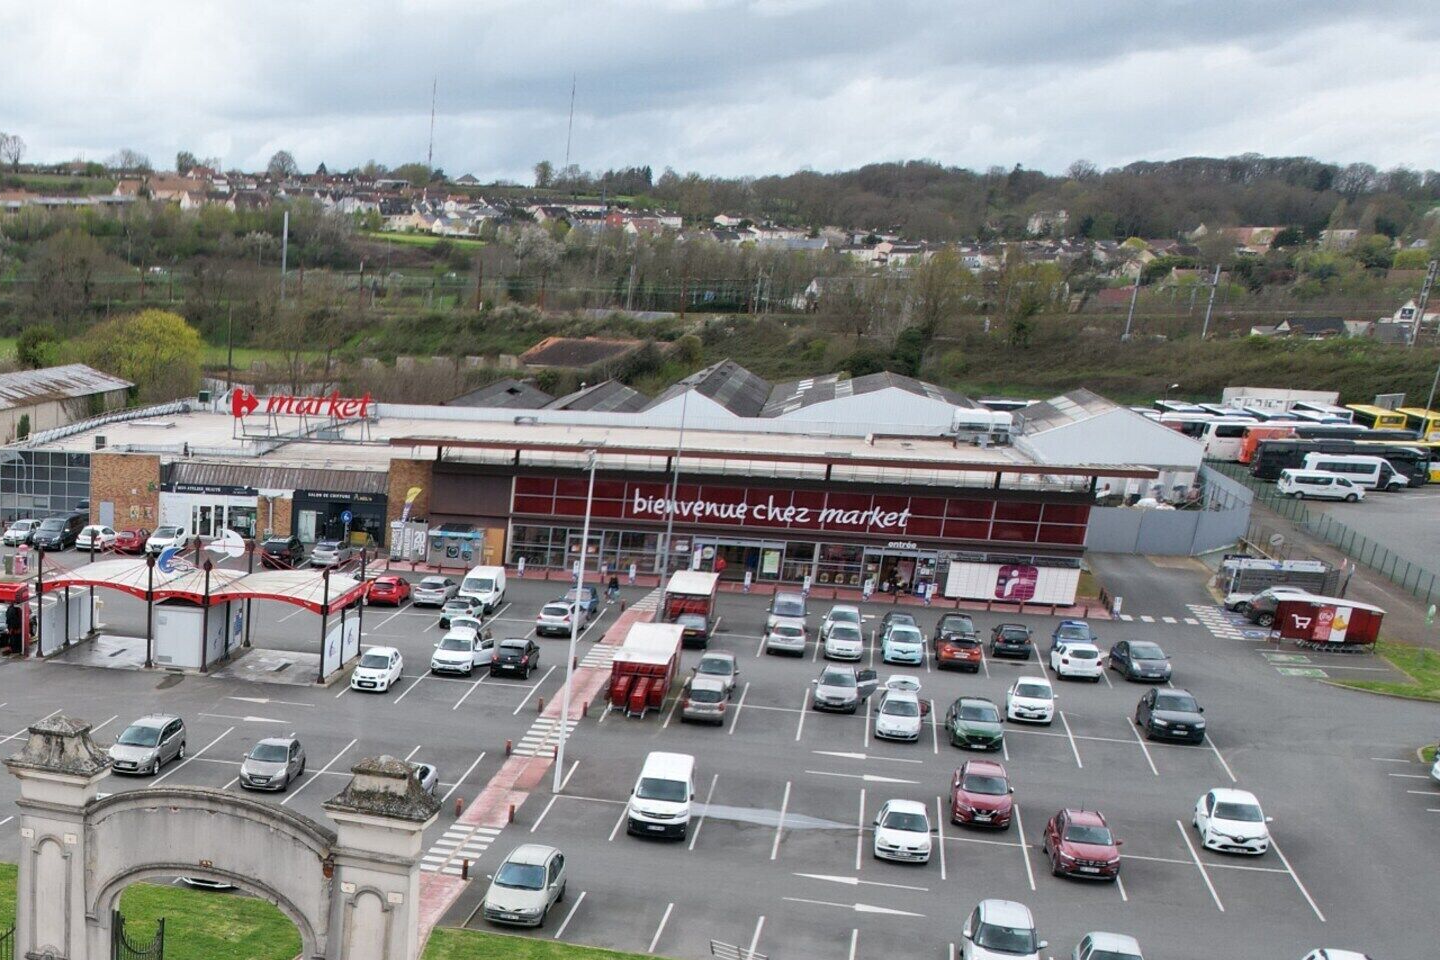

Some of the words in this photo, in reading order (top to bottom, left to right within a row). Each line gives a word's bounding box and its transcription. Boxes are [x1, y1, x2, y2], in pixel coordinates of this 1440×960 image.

[265, 389, 374, 420] market
[632, 487, 747, 520] bienvenue
[752, 495, 811, 523] chez
[818, 506, 913, 529] market
[888, 540, 917, 549] entrée
